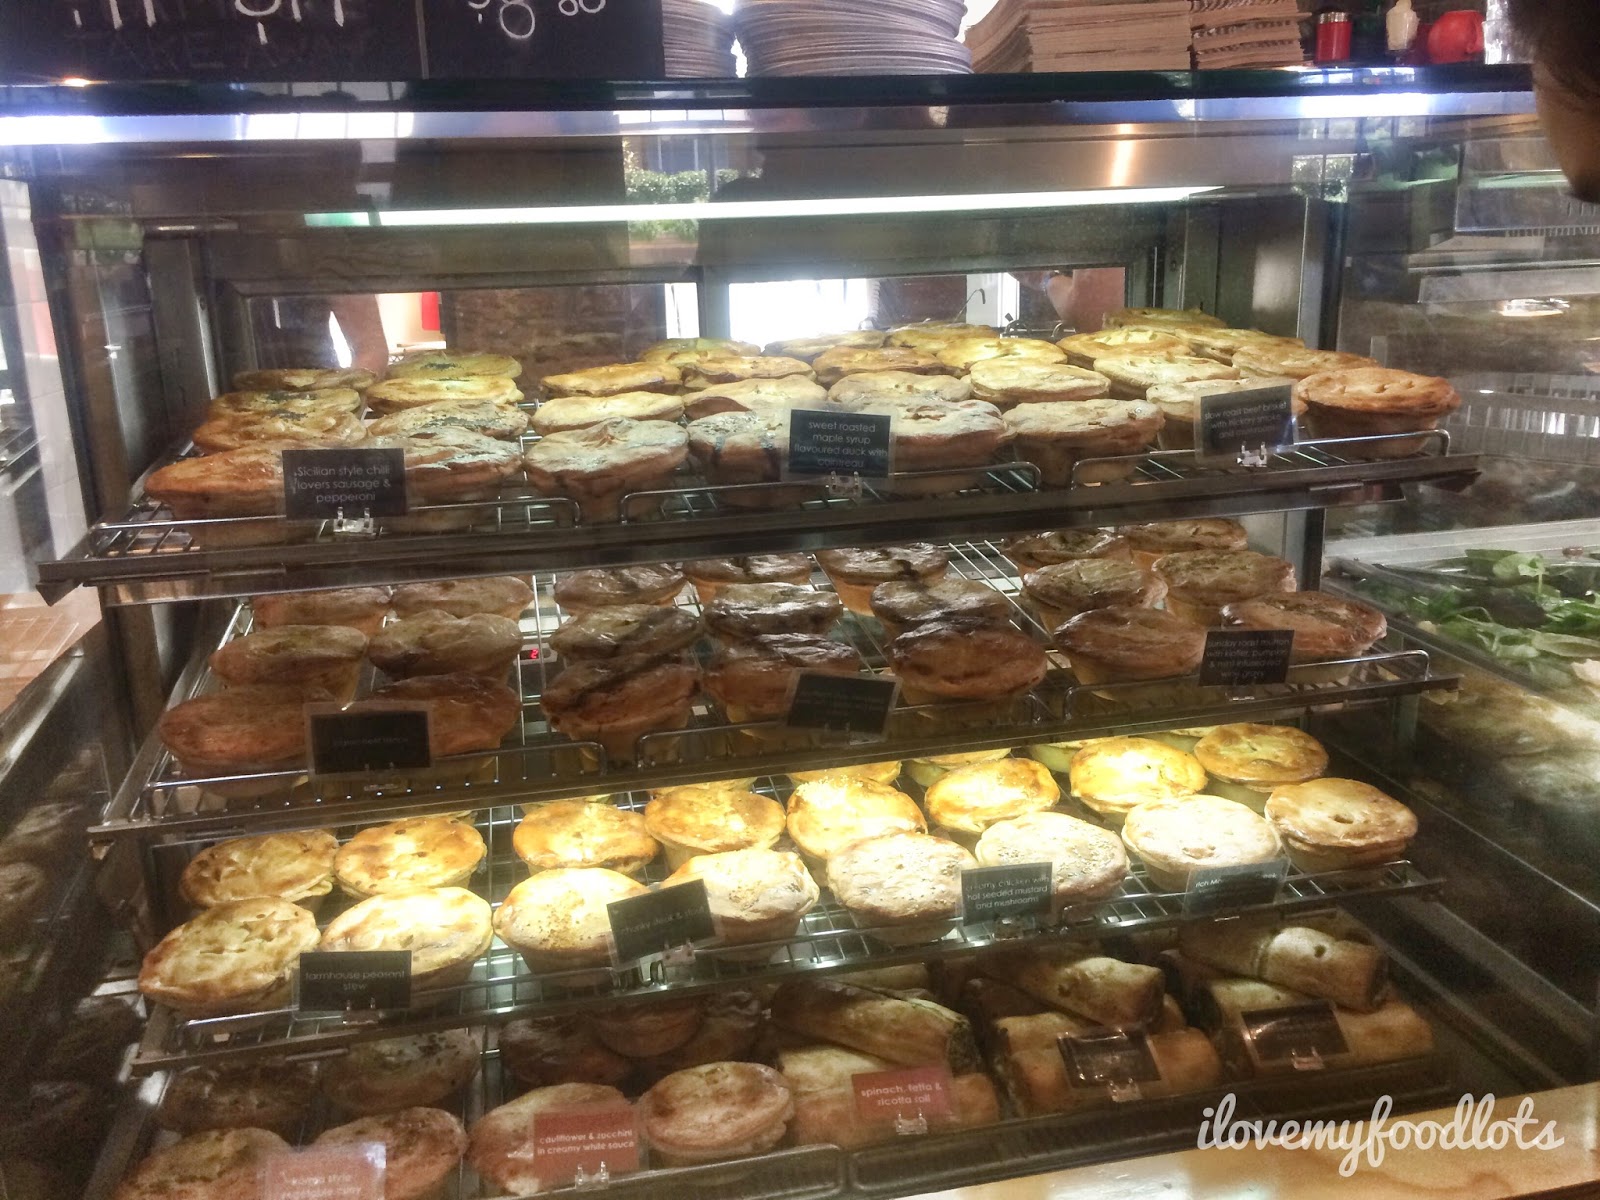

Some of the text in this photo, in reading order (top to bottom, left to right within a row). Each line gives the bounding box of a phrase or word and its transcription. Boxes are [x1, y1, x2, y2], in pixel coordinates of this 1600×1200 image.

[808, 421, 876, 433] sweet roasted
[812, 433, 871, 445] maple syrup
[794, 443, 888, 457] flavoured duck with
[297, 464, 391, 478] Sicilian style chilli
[297, 478, 391, 490] lovers sausage &
[315, 492, 376, 504] pepperoni
[982, 888, 1013, 900] seeded
[1014, 885, 1048, 895] mustard
[975, 901, 993, 910] and
[935, 1082, 942, 1090] &
[877, 1096, 912, 1107] ricotta
[540, 1133, 587, 1145] cauliflower
[588, 1132, 594, 1140] &
[547, 1144, 581, 1155] creamy
[607, 1140, 635, 1150] sauce
